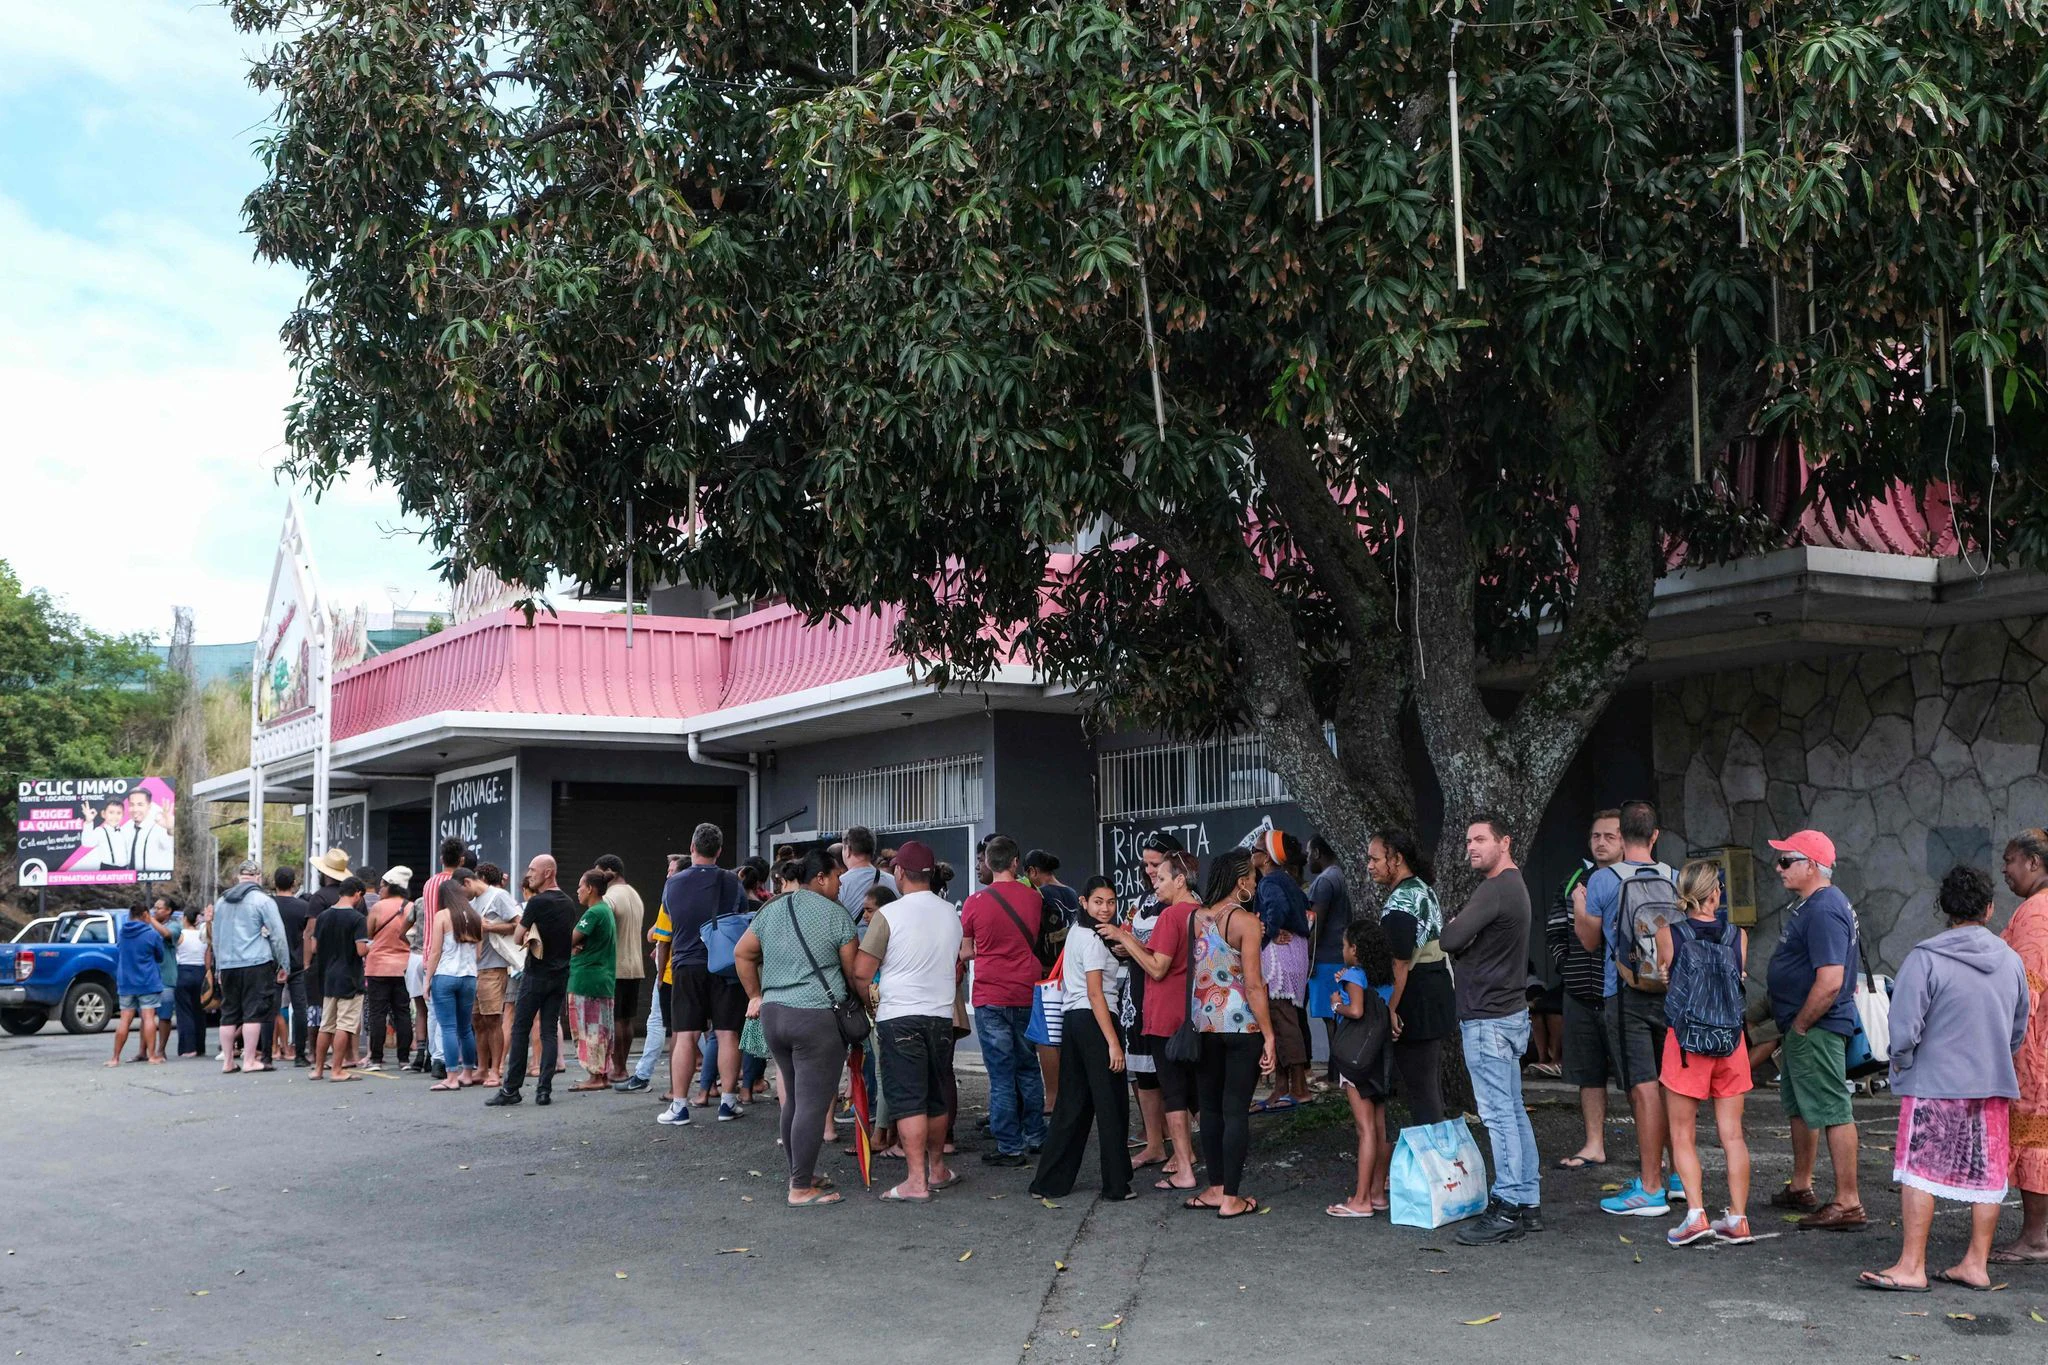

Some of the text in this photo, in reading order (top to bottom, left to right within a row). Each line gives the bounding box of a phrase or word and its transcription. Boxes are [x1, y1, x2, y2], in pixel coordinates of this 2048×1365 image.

[18, 779, 128, 796] D'CLIC IMMO
[448, 776, 504, 814] ARRIVAGE:
[32, 809, 71, 819] EXIGEZ
[20, 818, 83, 832] LA QUALITÉ
